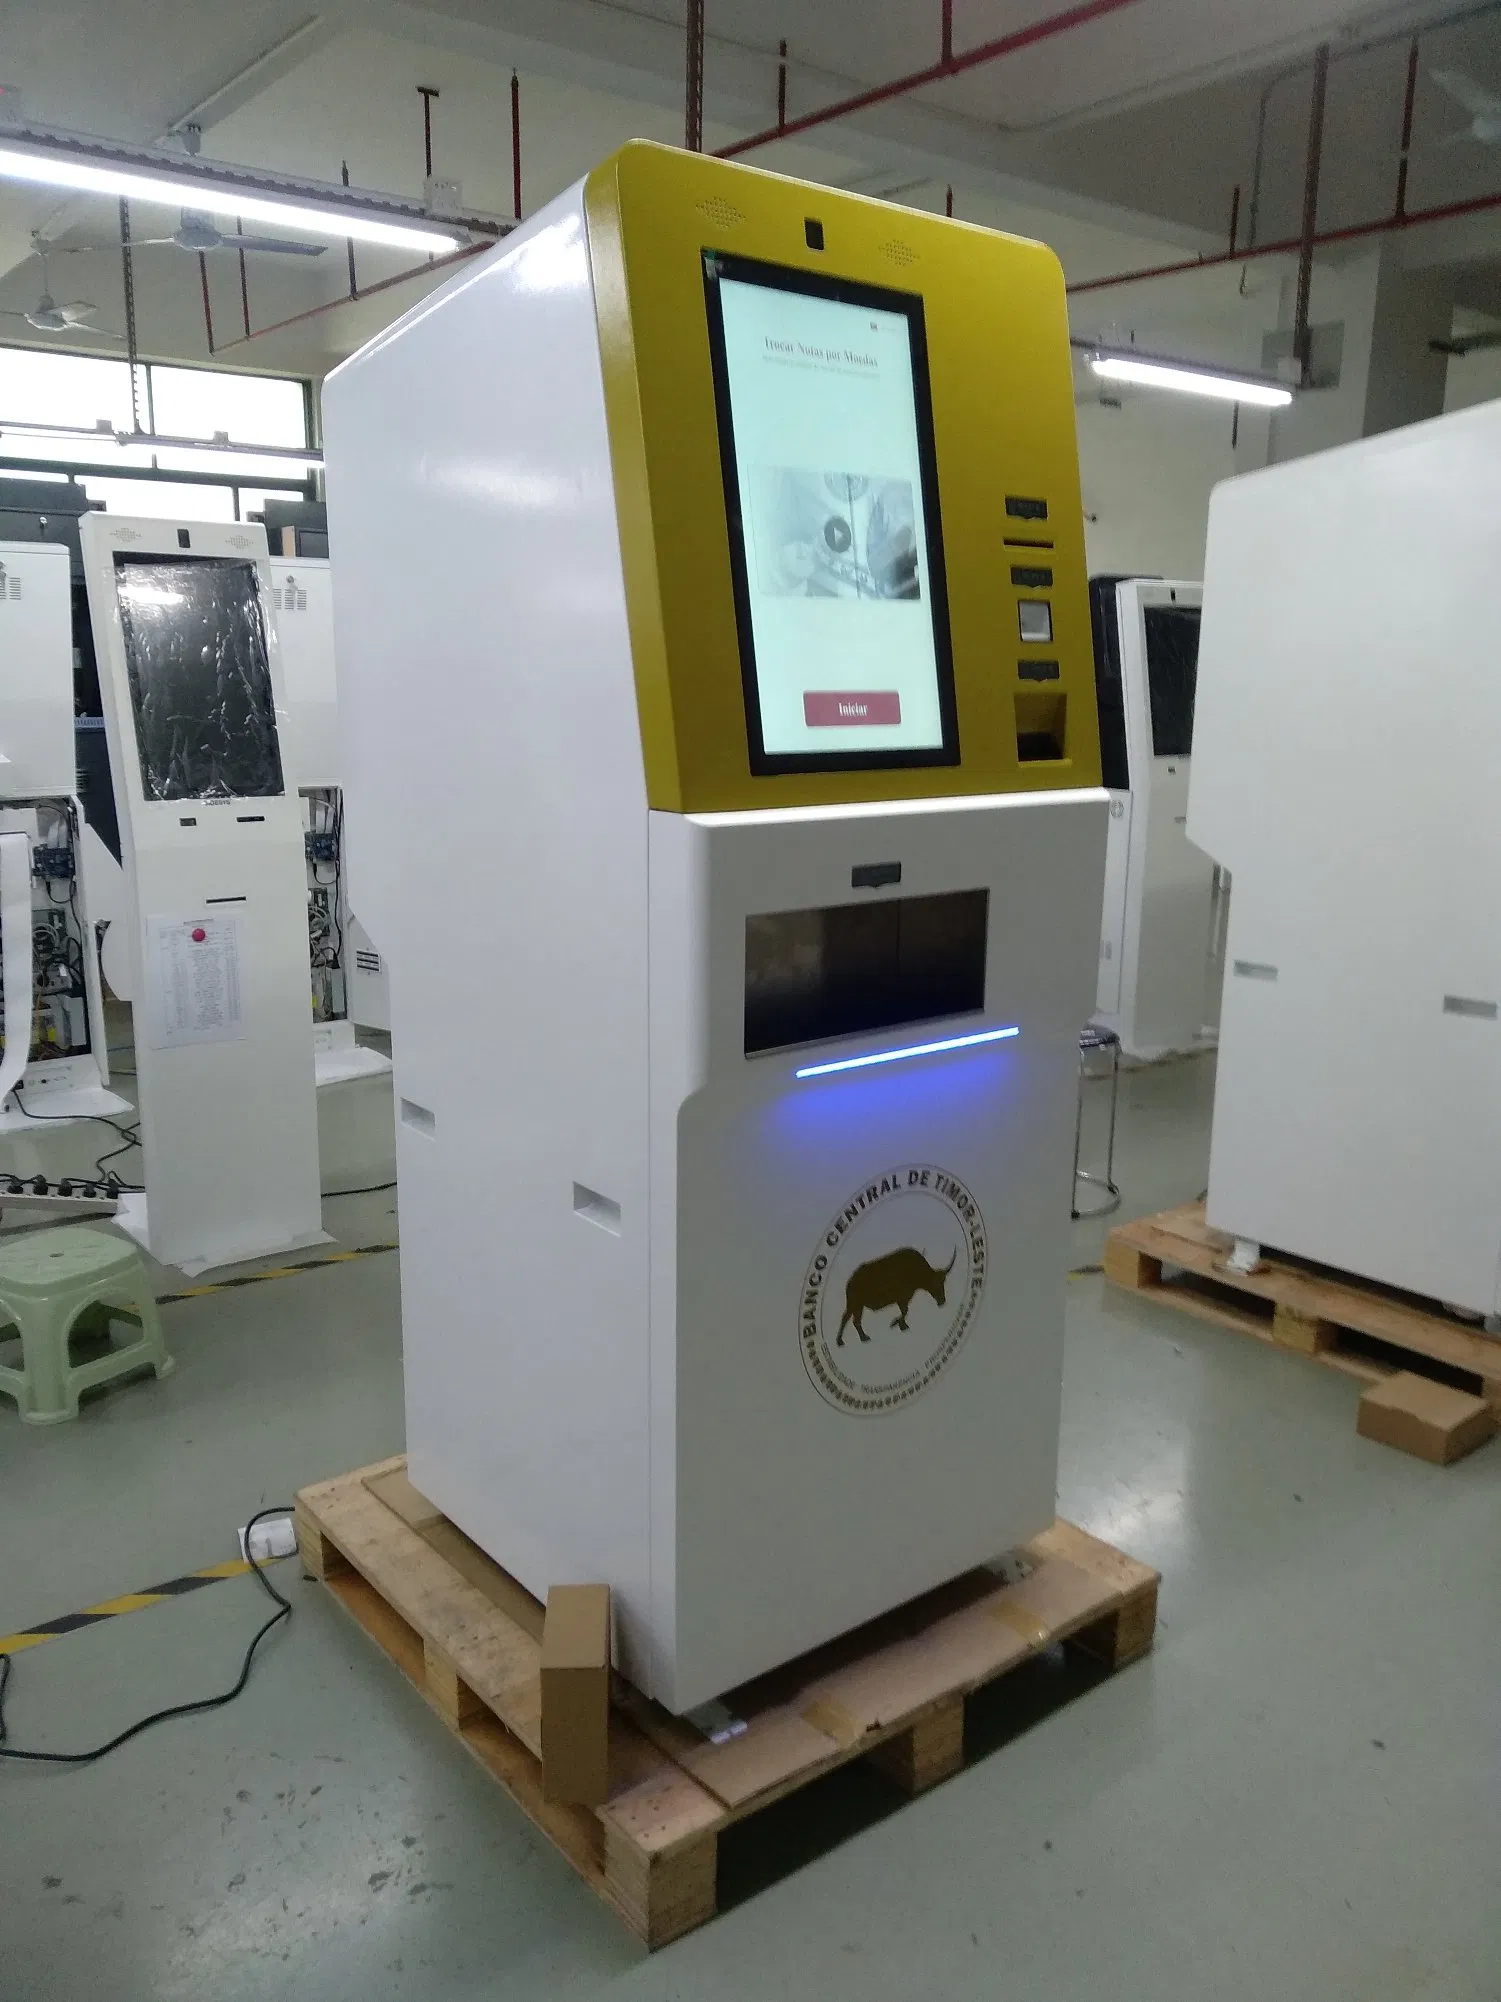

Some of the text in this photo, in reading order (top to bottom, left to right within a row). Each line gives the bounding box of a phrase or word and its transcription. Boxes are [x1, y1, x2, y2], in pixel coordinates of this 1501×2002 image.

[826, 349, 841, 363] por
[838, 702, 868, 716] Iniciar
[803, 1170, 984, 1338] BANCO CENTRAL DE TIMOR-LESTE
